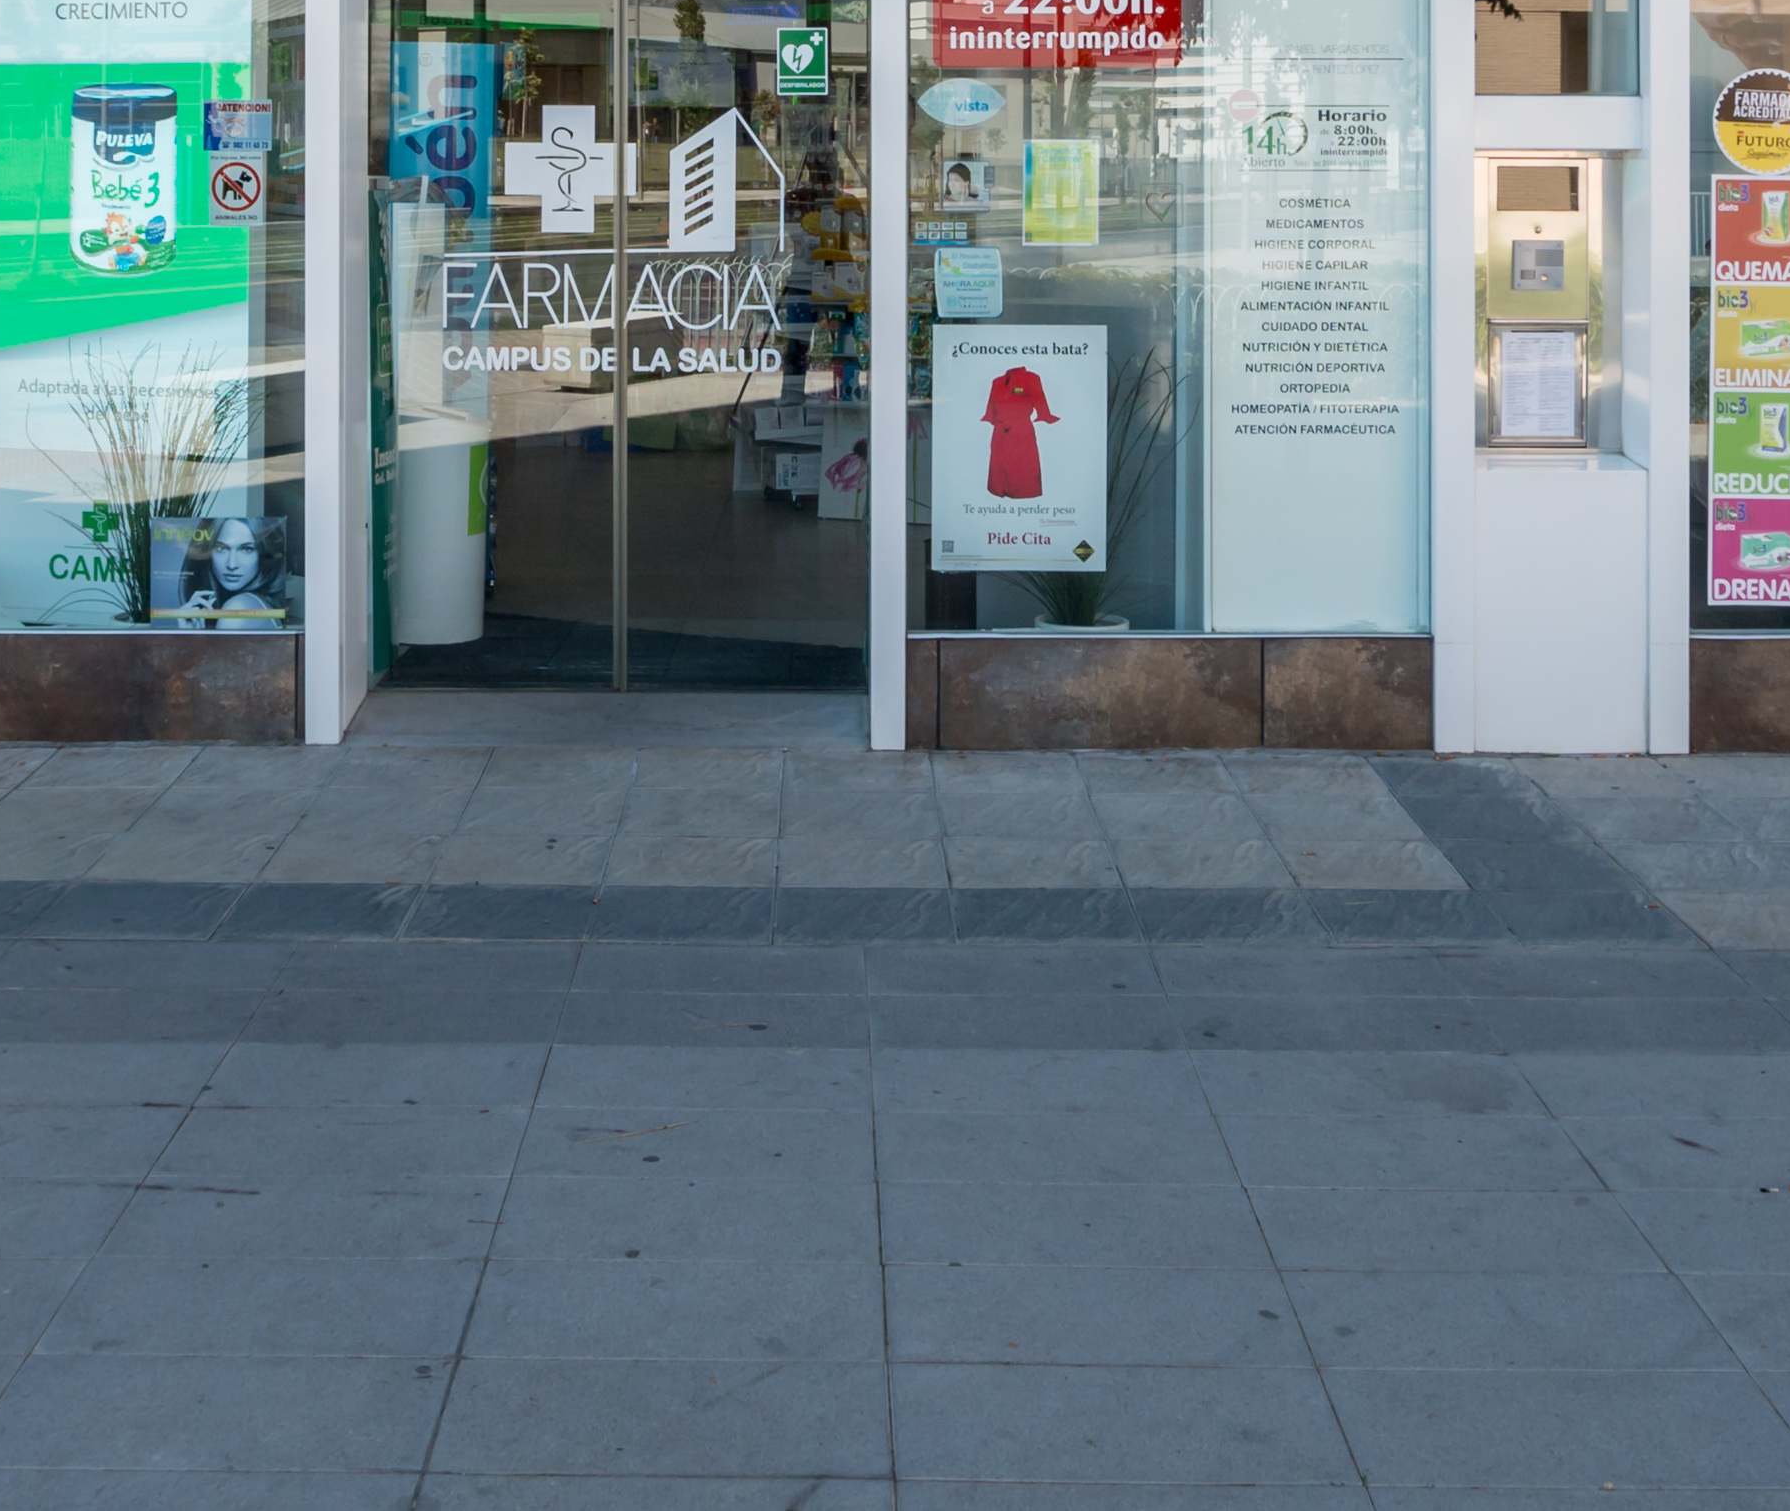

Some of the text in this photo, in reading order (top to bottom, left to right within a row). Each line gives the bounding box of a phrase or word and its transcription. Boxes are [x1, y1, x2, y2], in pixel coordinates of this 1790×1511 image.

[55, 1, 188, 20] CRECIMIENTO
[982, 0, 994, 14] a
[950, 26, 1164, 56] ininterrumpido
[955, 100, 988, 111] vista
[1318, 110, 1387, 121] Horario
[1334, 125, 1377, 135] 8:00h.
[96, 131, 153, 148] PULEVA
[91, 170, 160, 208] Bebé 3
[1279, 197, 1351, 209] COSMÉTICA
[1266, 219, 1364, 229] MEDICAMENTOS
[1254, 240, 1375, 250] HIGIENE CORPORAL
[1262, 261, 1368, 270] HIGIENE CAPILAR
[1261, 281, 1369, 290] HIGIENE INFANTIL
[442, 262, 782, 331] FARMACIA
[1240, 300, 1389, 311] ALIMENTACIÓN INFANTIL
[1262, 322, 1368, 332] CUIDADO DENTAL
[952, 342, 1088, 358] ¿Conoces esta bata?
[1242, 341, 1388, 352] NUTRICIÓN Y DIETÉTICA
[442, 346, 782, 374] CAMPUS DE LA SALUD
[1245, 361, 1385, 373] NUTRICIÓN DEPORTIVA
[17, 378, 89, 398] Adaptada
[1280, 384, 1350, 393] ORTOPEDIA
[1231, 402, 1399, 414] HOMEOPATÍA / FITOTERAPIA
[1235, 423, 1395, 435] ATENCIÓN FARMACÉUTICA
[963, 504, 975, 514] Te
[978, 504, 1008, 517] ayuda
[1017, 504, 1050, 517] perder
[1053, 506, 1076, 517] peso
[987, 532, 1051, 545] Pide Cita
